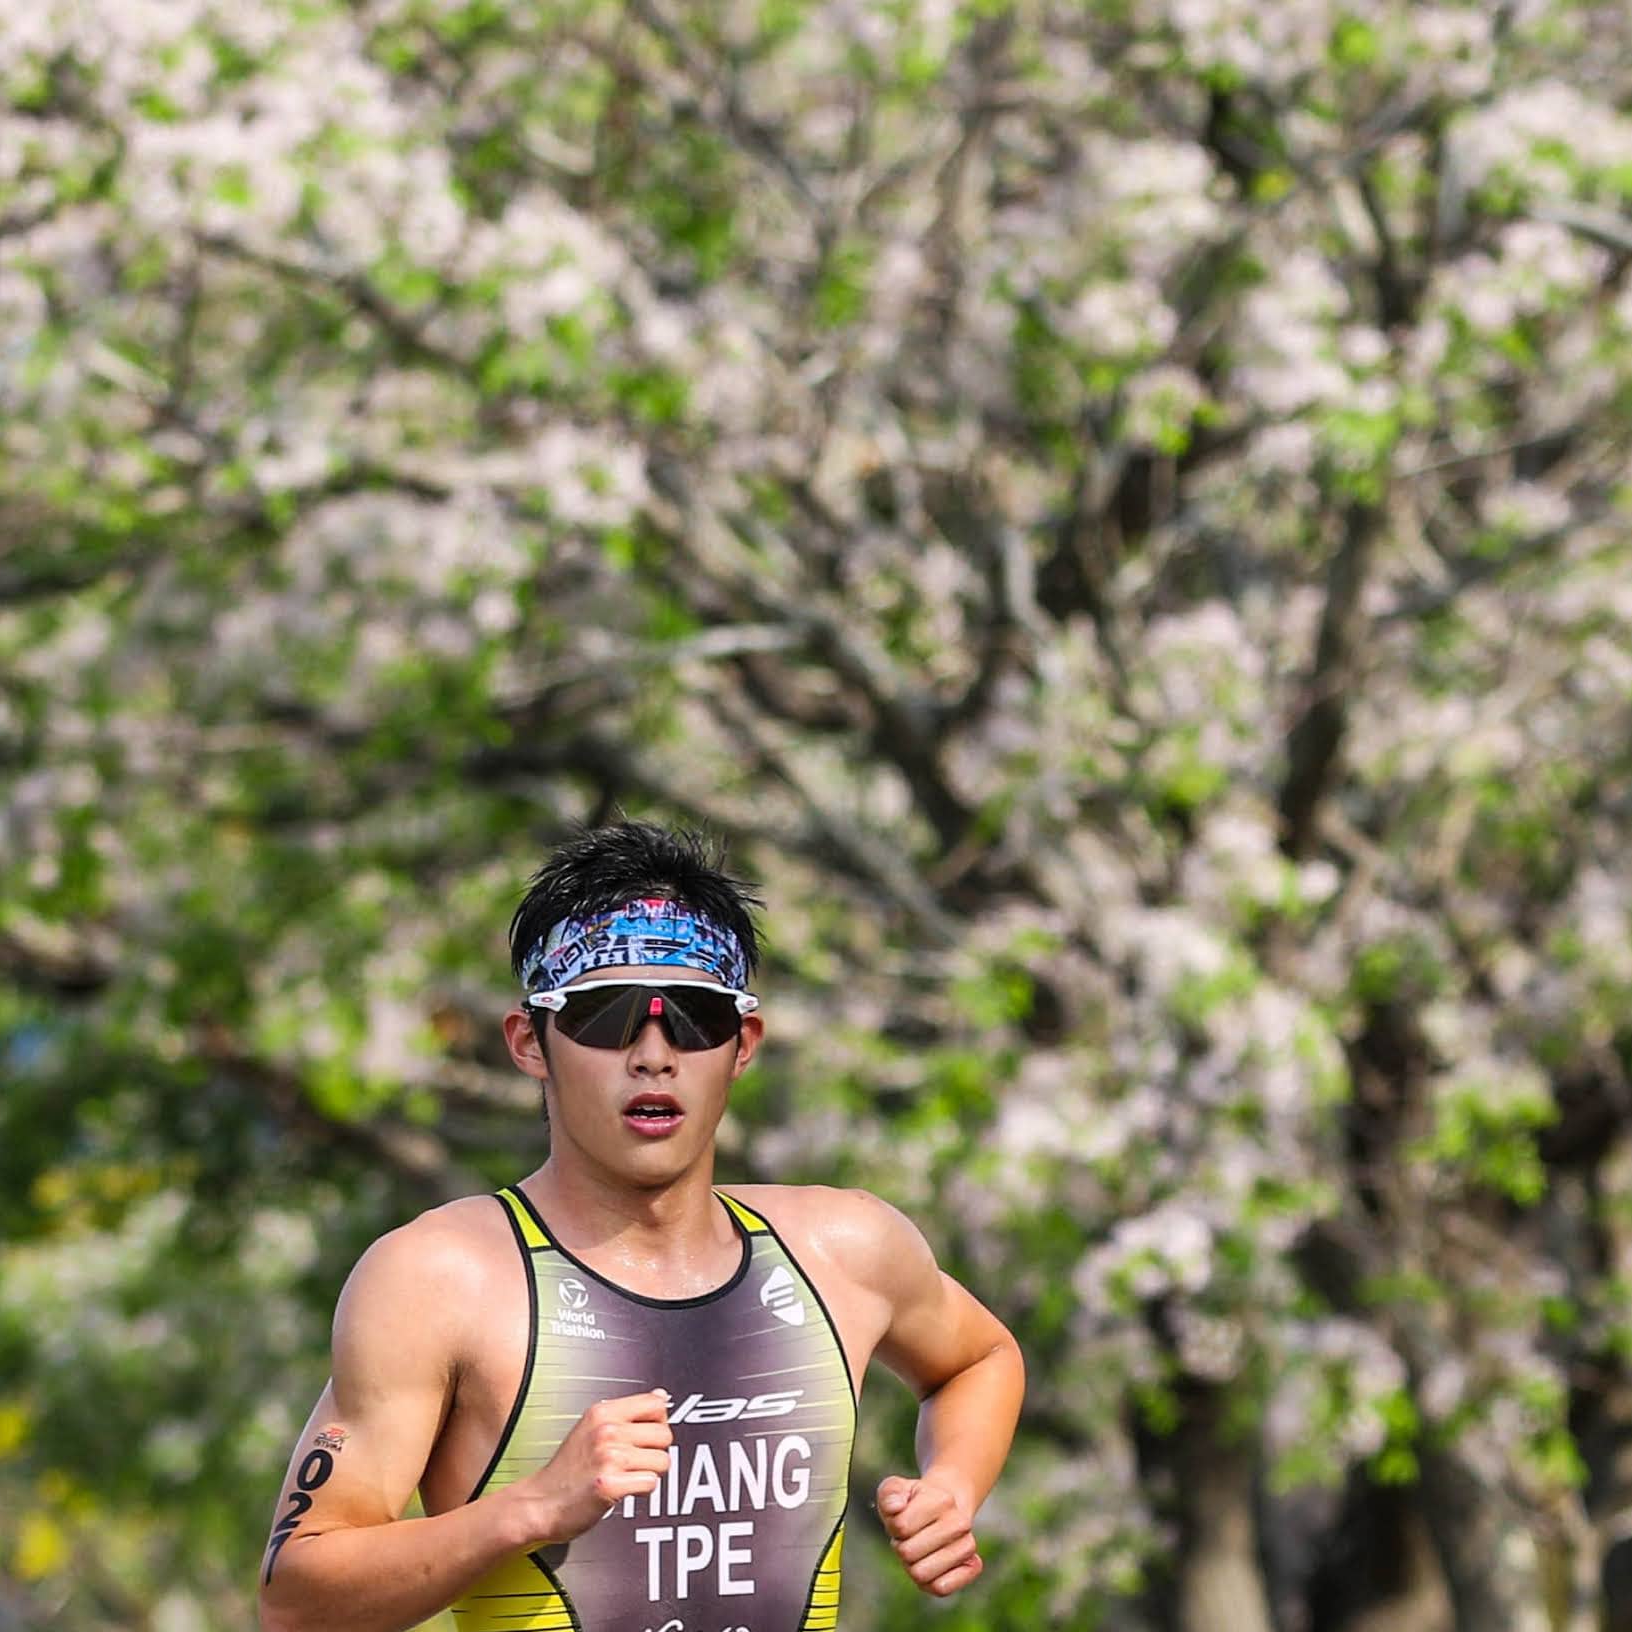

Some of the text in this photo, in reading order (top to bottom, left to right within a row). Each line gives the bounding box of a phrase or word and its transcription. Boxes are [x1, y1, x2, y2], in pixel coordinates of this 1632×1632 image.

[557, 1309, 595, 1326] World
[549, 1320, 606, 1340] Triathlon
[634, 1521, 756, 1601] TPE
